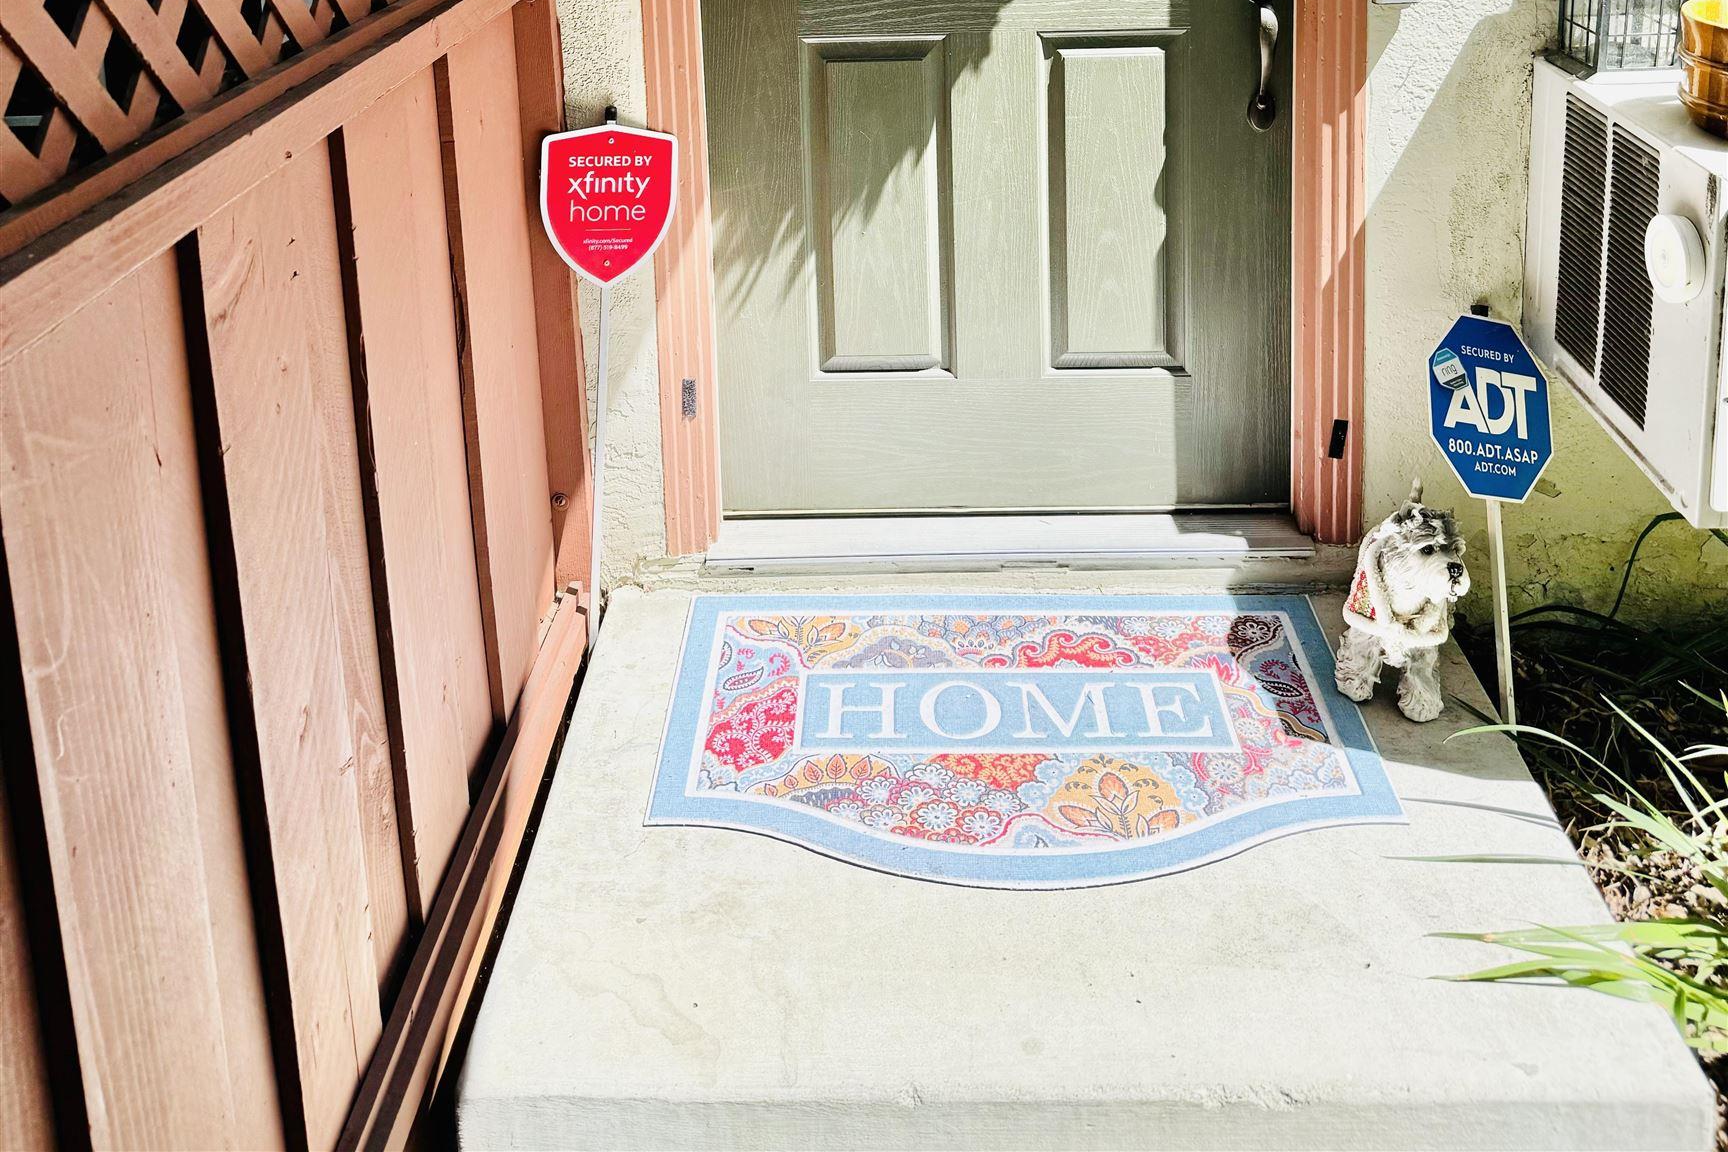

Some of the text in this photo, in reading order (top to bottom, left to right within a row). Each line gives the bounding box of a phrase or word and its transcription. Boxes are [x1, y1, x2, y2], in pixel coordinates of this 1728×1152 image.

[568, 155, 653, 168] SECURED BY
[567, 170, 651, 200] xfinity
[569, 200, 647, 223] home
[1460, 345, 1502, 361] SECURED
[1503, 354, 1515, 364] BY
[1443, 366, 1537, 440] ADT
[1448, 438, 1539, 465] 800.ADT.ASAP
[1474, 462, 1517, 477] ADT.COM
[814, 680, 1214, 740] HOME
